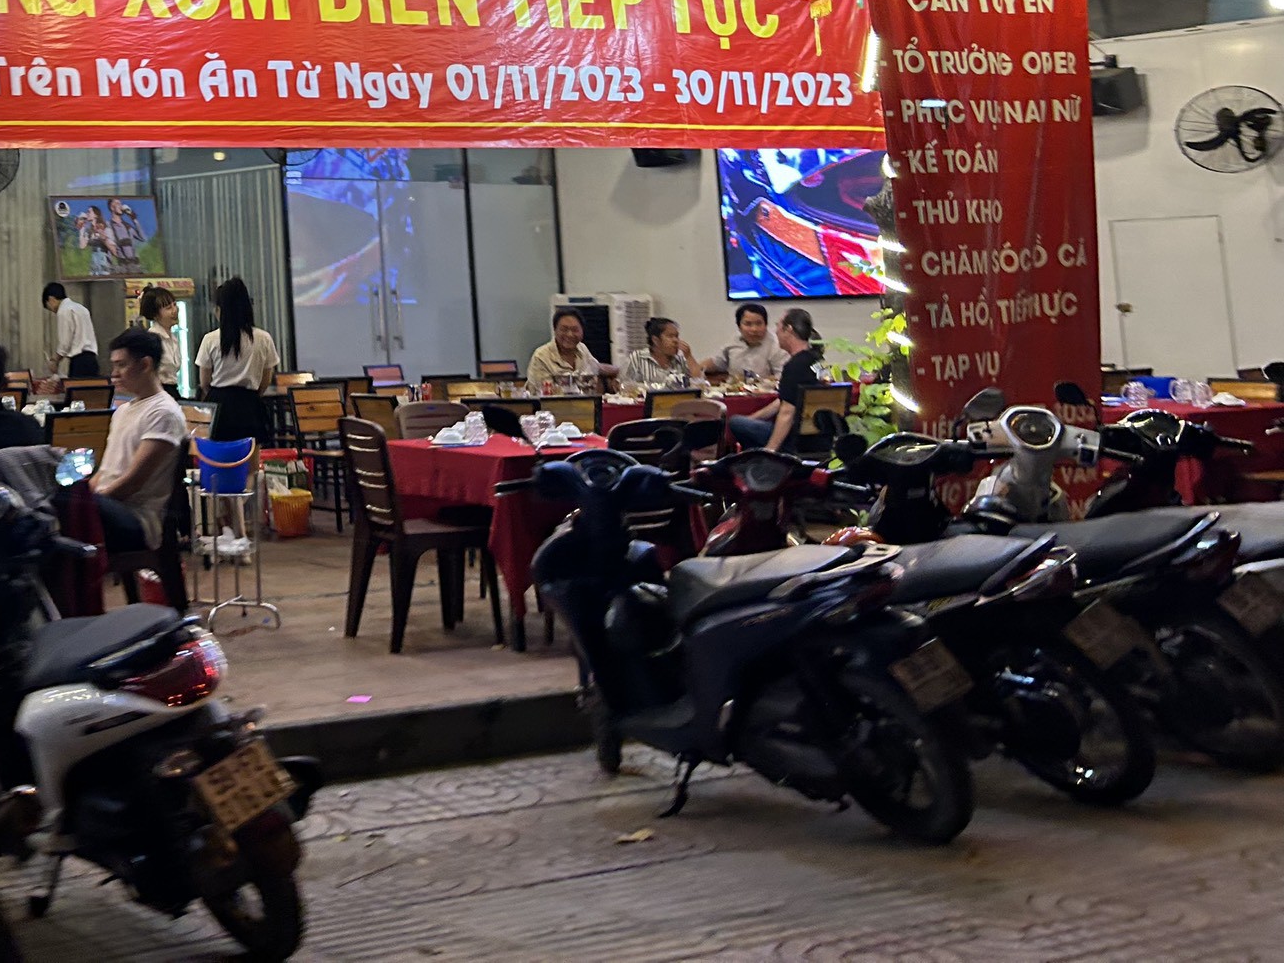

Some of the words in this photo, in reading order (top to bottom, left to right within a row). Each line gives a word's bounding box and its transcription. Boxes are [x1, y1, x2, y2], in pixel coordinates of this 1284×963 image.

[892, 36, 926, 74] TỔ
[927, 42, 1014, 77] TRƯỞNG
[95, 57, 186, 99] Món
[198, 51, 258, 103] Ăn
[266, 59, 322, 99] Từ
[333, 61, 434, 110] Ngày
[446, 62, 645, 110] 01/11/2023
[671, 68, 854, 115] 30/11/2023
[905, 139, 939, 174] KẾ
[942, 141, 999, 174] TOÁN
[912, 190, 959, 225] THỦ
[965, 198, 1003, 225] KHO
[920, 243, 989, 277] CHĂM
[931, 353, 971, 388] TẠP
[974, 350, 1001, 383] VỤ
